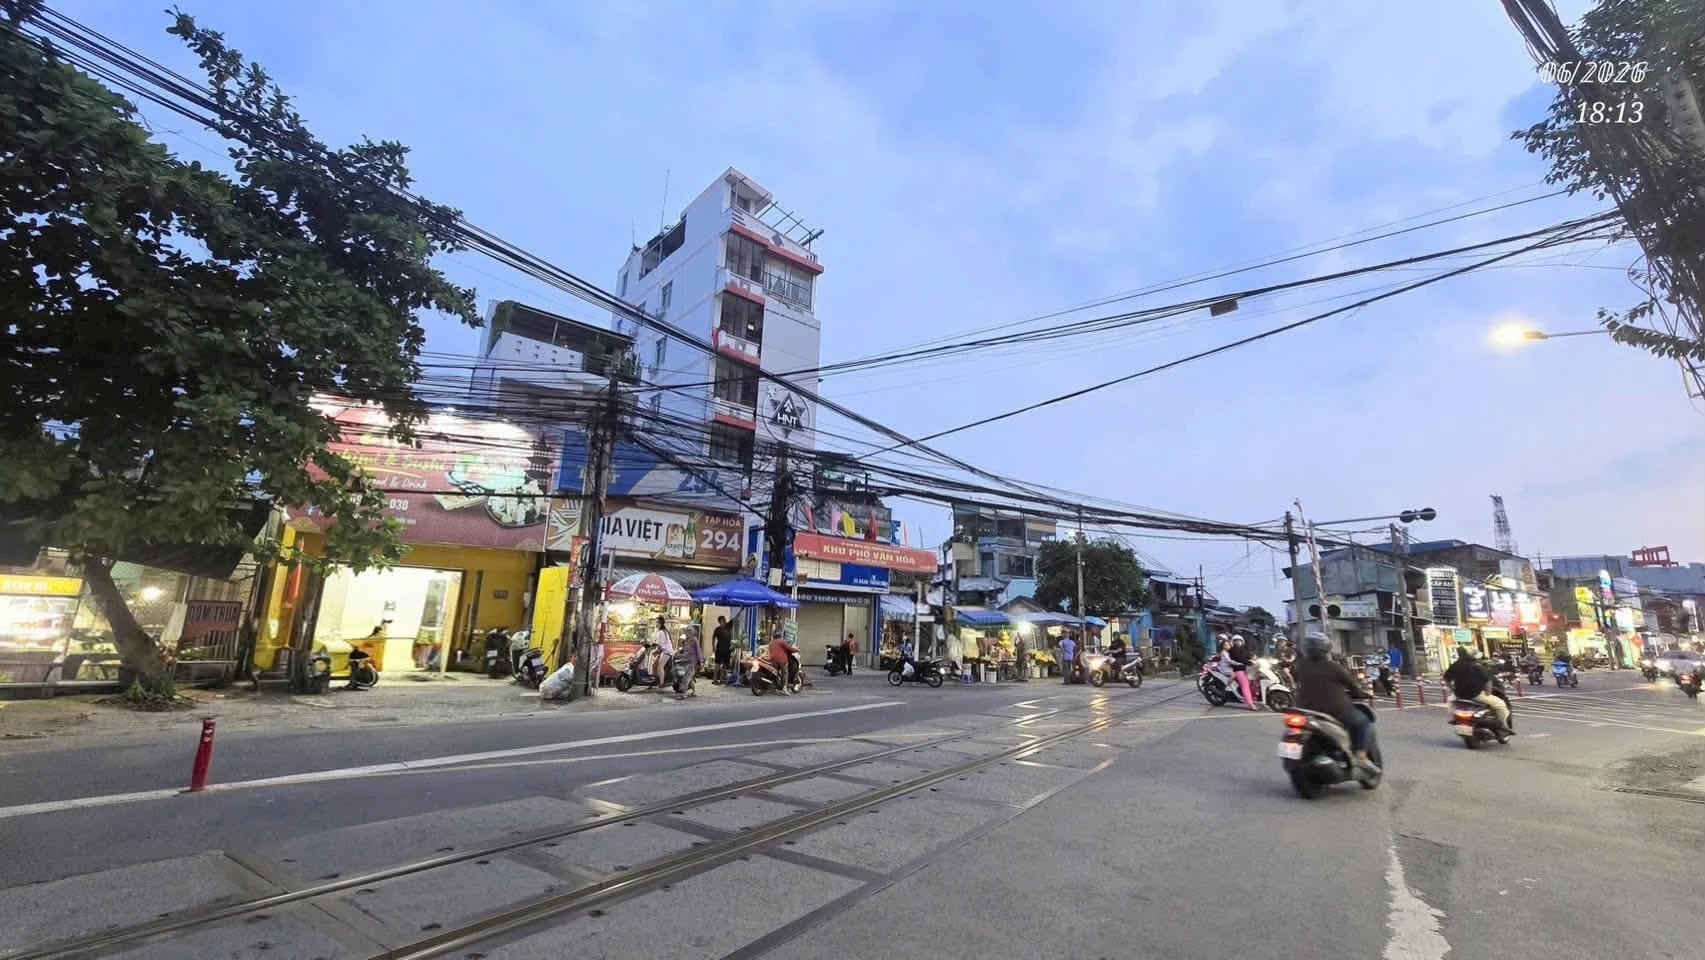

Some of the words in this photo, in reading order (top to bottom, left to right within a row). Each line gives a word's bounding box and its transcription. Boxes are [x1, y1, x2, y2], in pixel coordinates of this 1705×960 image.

[777, 412, 798, 426] HNT
[389, 498, 409, 512] 030
[626, 517, 663, 542] VIỆT
[701, 529, 741, 552] 294
[823, 545, 847, 556] KHU
